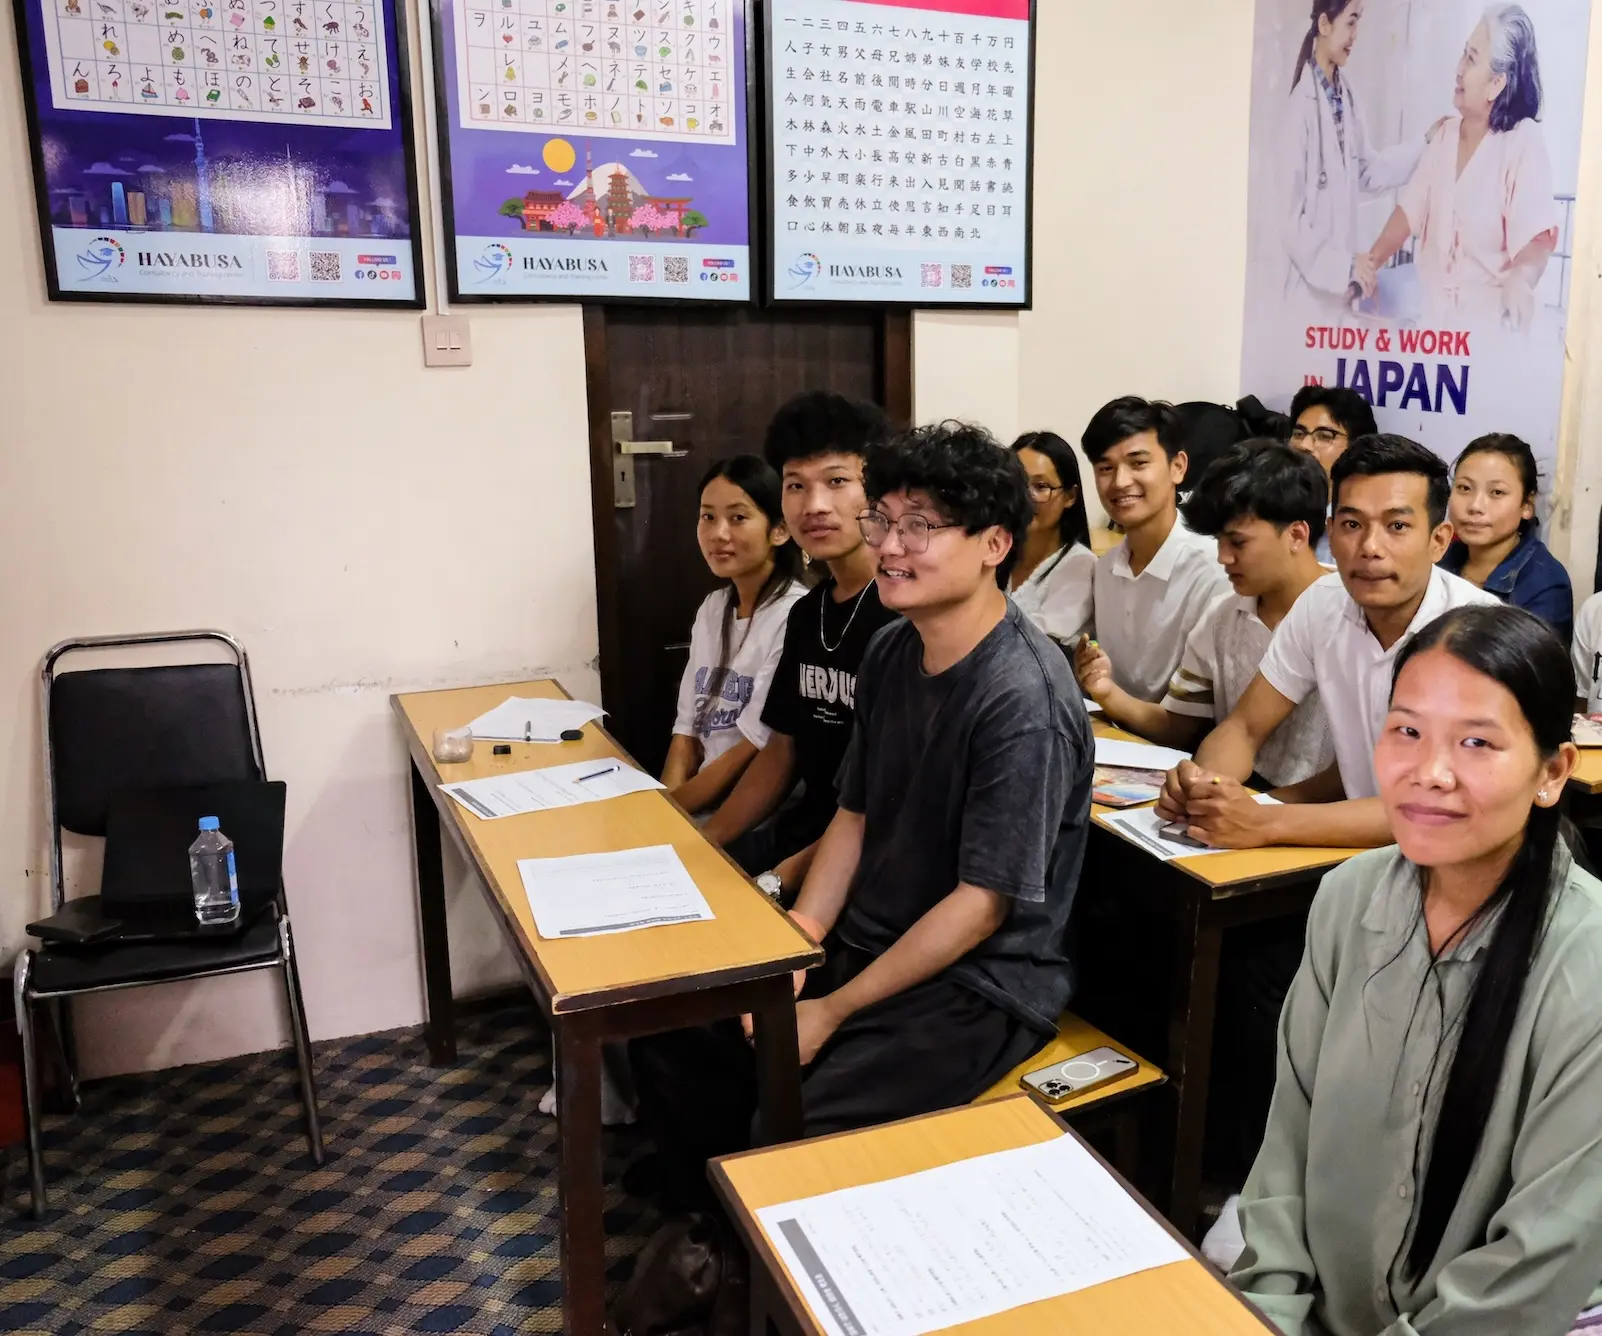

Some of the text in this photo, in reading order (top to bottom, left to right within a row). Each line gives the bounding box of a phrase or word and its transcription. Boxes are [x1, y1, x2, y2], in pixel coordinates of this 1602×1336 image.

[260, 1, 276, 11] つ
[292, 0, 306, 16] す
[325, 4, 333, 19] く
[355, 6, 365, 23] う
[683, 0, 695, 13] キ
[709, 1, 717, 15] イ
[102, 23, 118, 39] れ
[168, 30, 185, 44] め
[233, 35, 248, 50] ね
[264, 39, 277, 53] て
[295, 41, 310, 54] せ
[325, 42, 339, 58] け
[358, 45, 370, 61] え
[473, 13, 720, 50] ヲ ル ユ ム フ ヌ ツ ス ク ウ
[72, 61, 374, 98] ん ろ よ も ほ の と そ こ お
[504, 53, 515, 66] レ
[556, 57, 568, 71] メ
[609, 60, 620, 77] ネ
[634, 64, 647, 78] テ
[660, 65, 671, 80] セ
[685, 67, 696, 81] ケ
[557, 93, 571, 107] モ
[584, 94, 597, 109] ホ
[685, 104, 695, 114] コ
[709, 103, 721, 117] オ
[138, 252, 242, 269] HAYABUSA
[523, 257, 608, 271] HAYABUSA
[830, 265, 902, 278] HAYABUSA
[1305, 326, 1471, 356] STUDY & WORK
[1336, 358, 1471, 415] JAPAN
